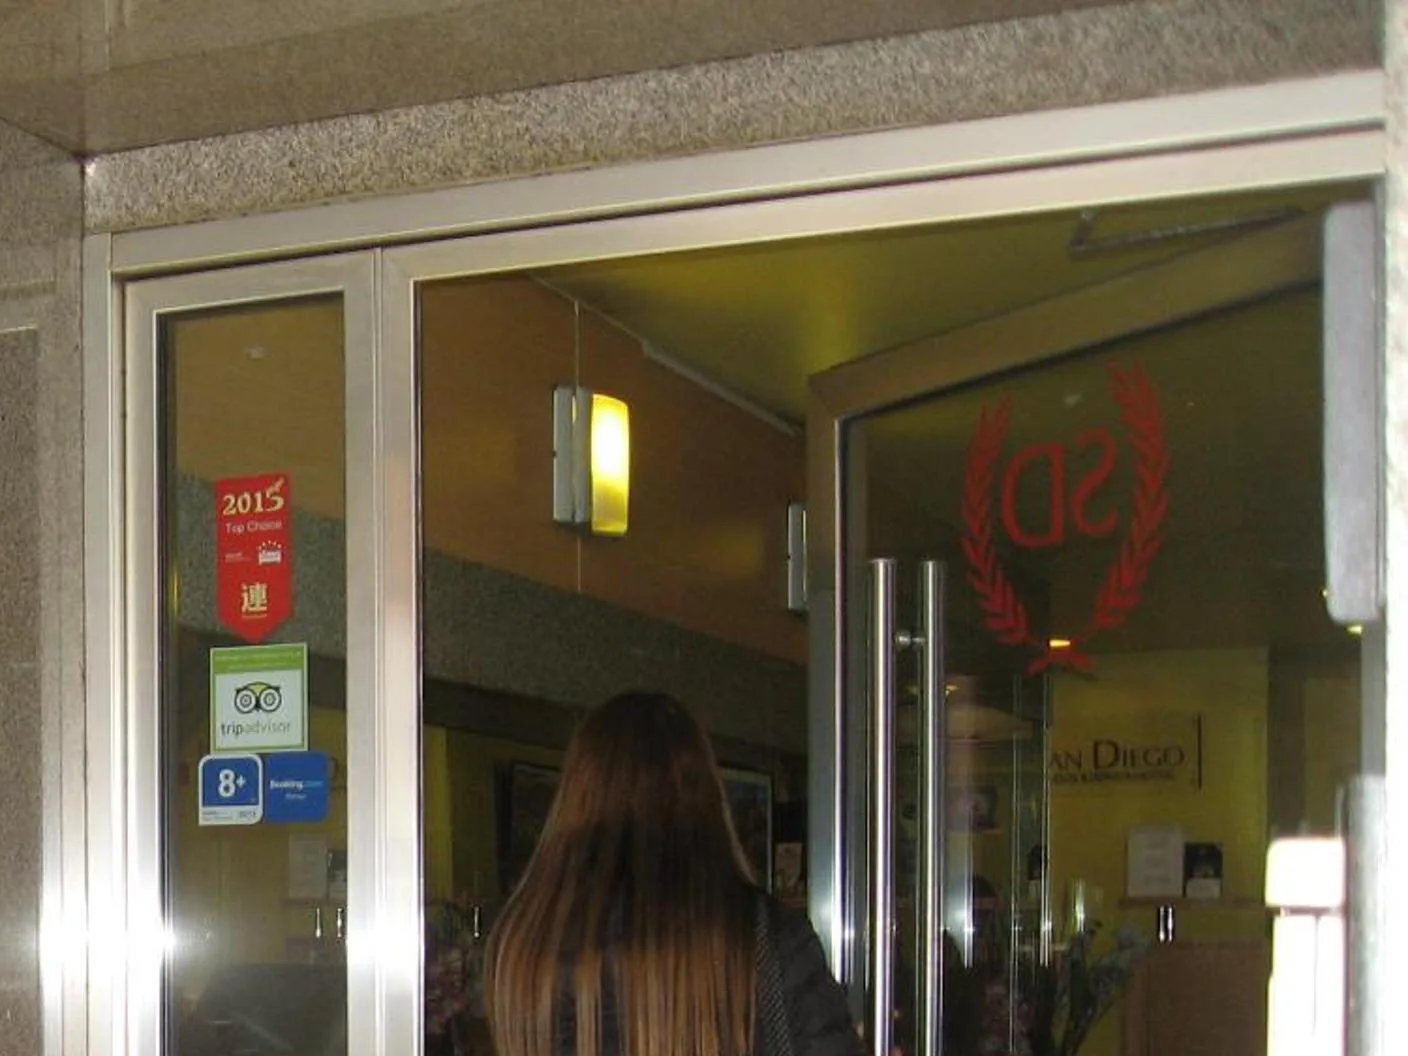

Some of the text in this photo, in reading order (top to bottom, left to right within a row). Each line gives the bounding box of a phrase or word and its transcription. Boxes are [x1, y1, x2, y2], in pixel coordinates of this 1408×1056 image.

[222, 477, 284, 516] 2015
[225, 522, 245, 535] Top
[220, 721, 291, 738] tripadvisor
[218, 768, 246, 798] 8+
